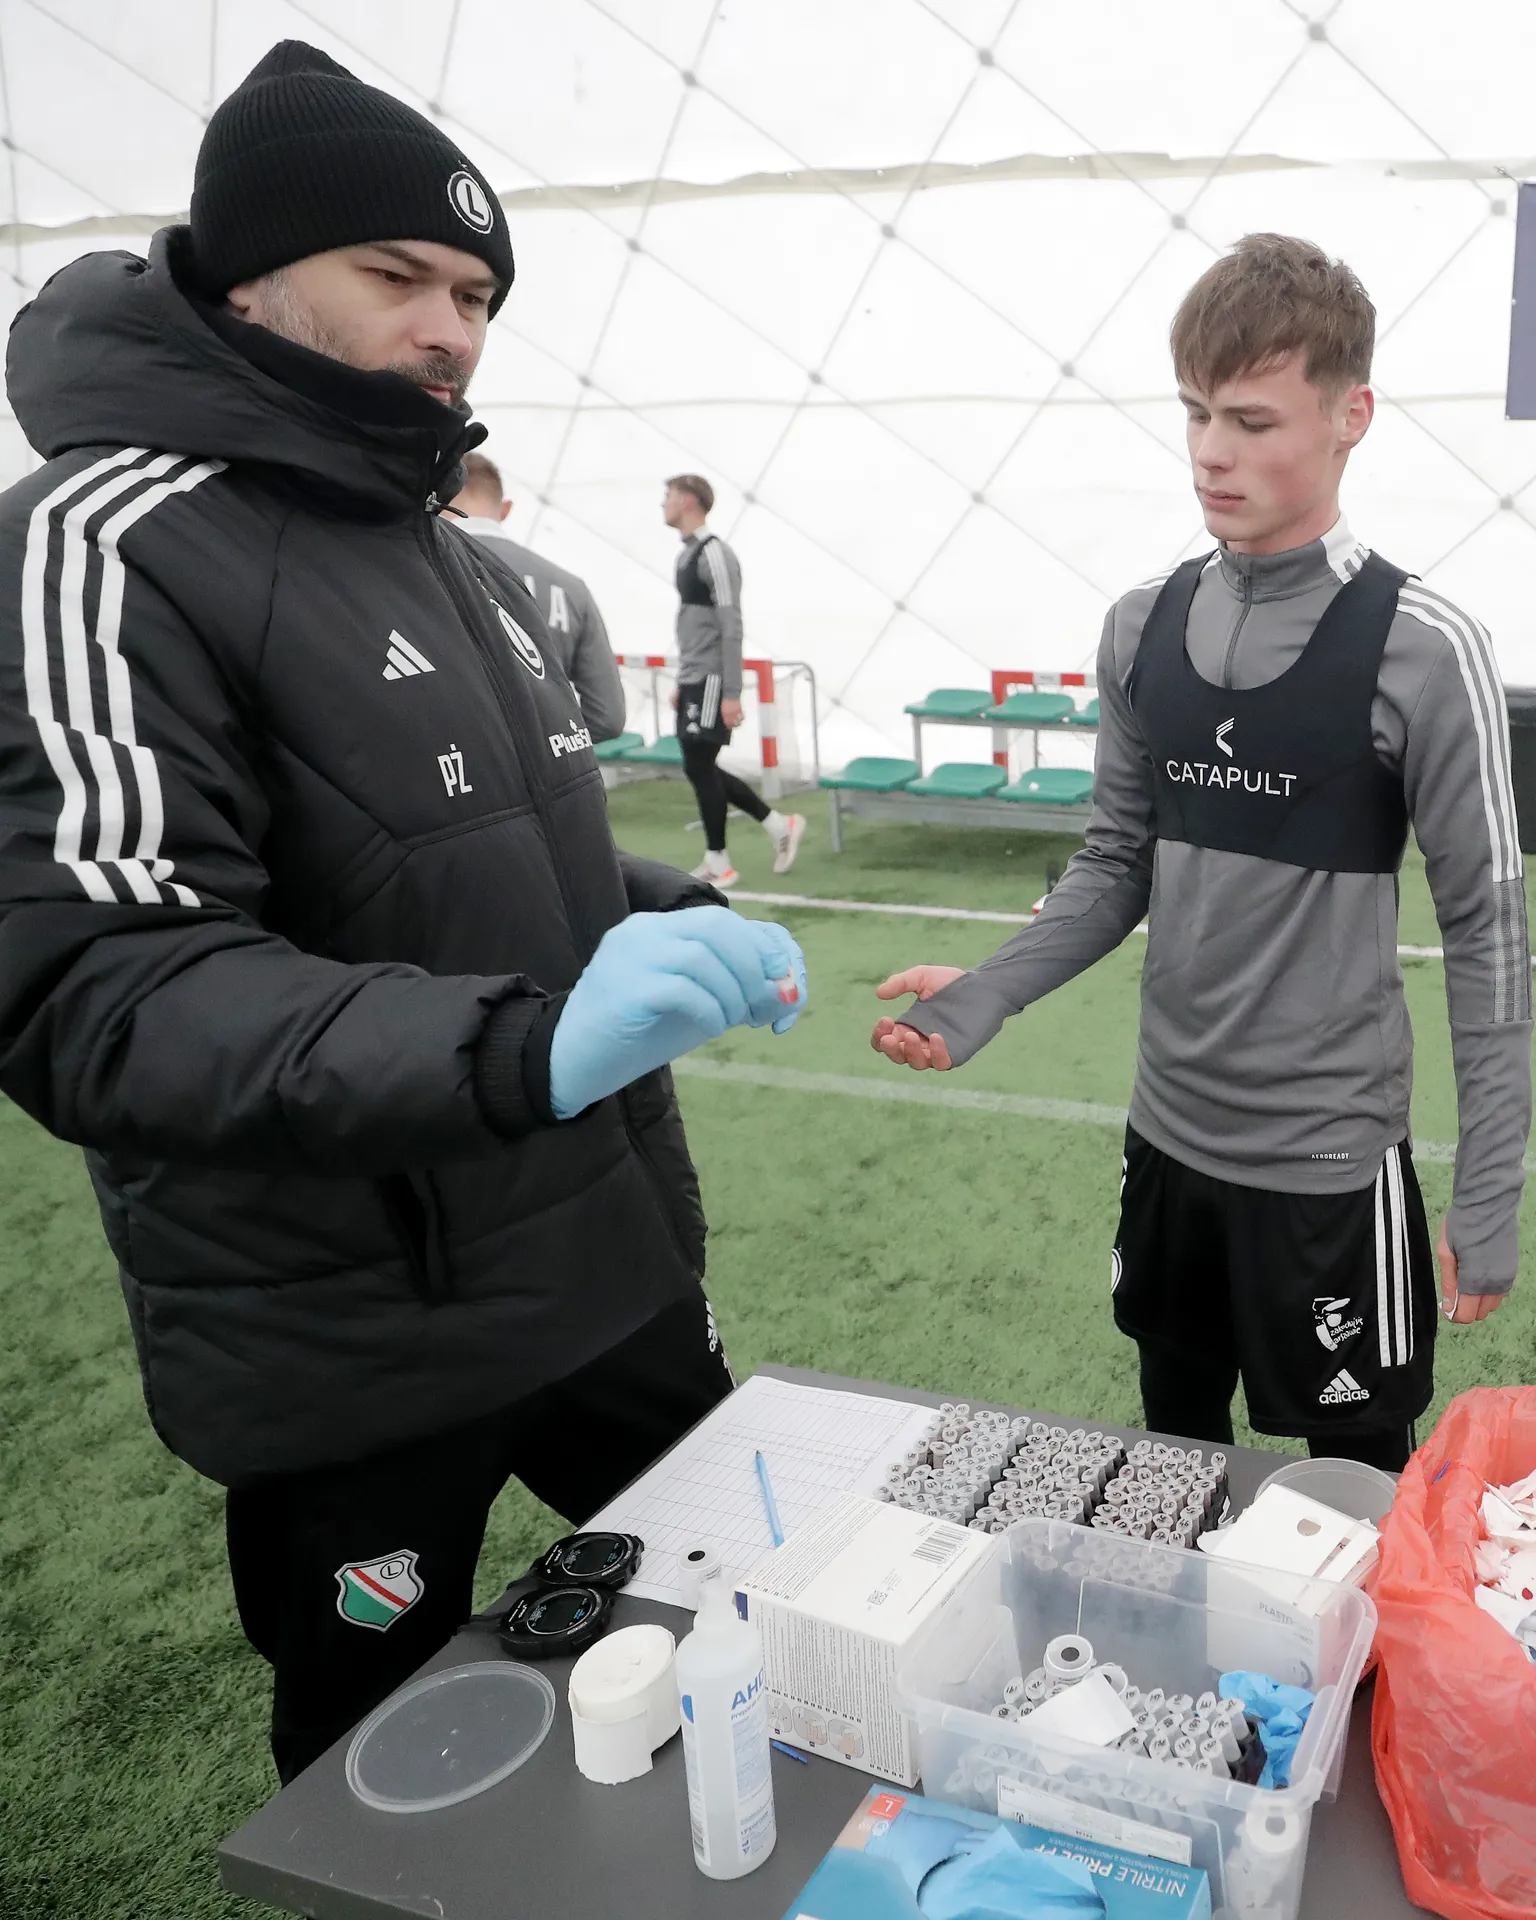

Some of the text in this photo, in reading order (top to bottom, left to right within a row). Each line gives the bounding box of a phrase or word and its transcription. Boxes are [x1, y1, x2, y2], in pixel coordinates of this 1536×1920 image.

[437, 743, 473, 797] PŻ
[1166, 759, 1297, 797] CATAPULT
[1319, 1388, 1370, 1404] adidas
[1114, 1866, 1187, 1898] NITRILE
